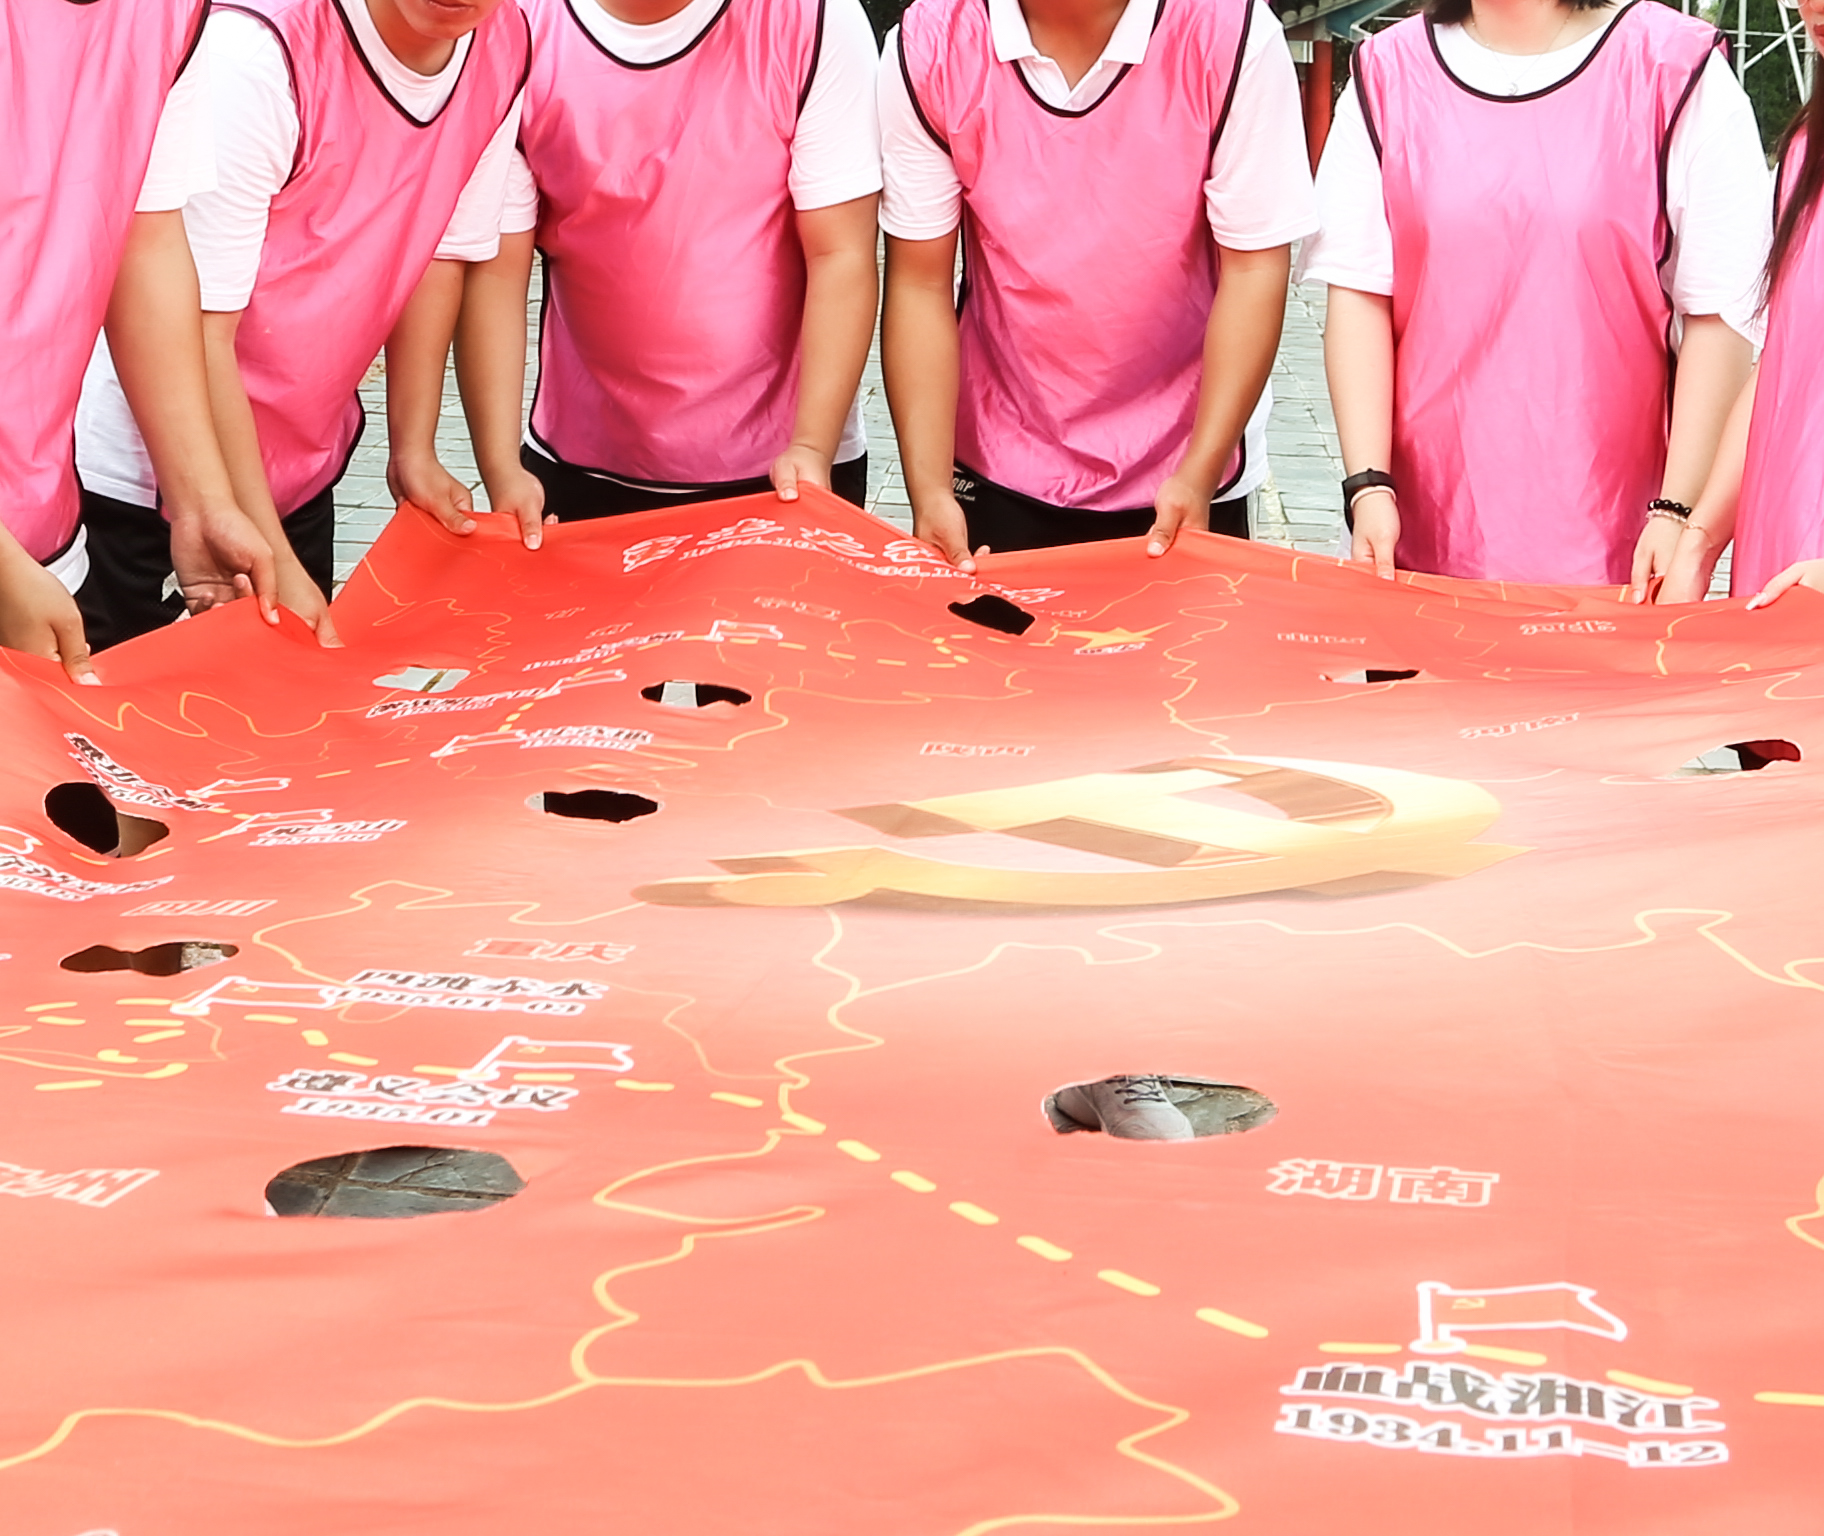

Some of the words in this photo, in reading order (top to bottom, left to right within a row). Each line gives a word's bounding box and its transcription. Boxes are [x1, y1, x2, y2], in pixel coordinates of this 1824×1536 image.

[463, 937, 636, 964] 重庆
[348, 968, 609, 1000] 四渡赤水
[266, 1068, 579, 1111] 遵义会议
[1265, 1158, 1500, 1207] 湖南
[1278, 1361, 1728, 1433] 血战湘江
